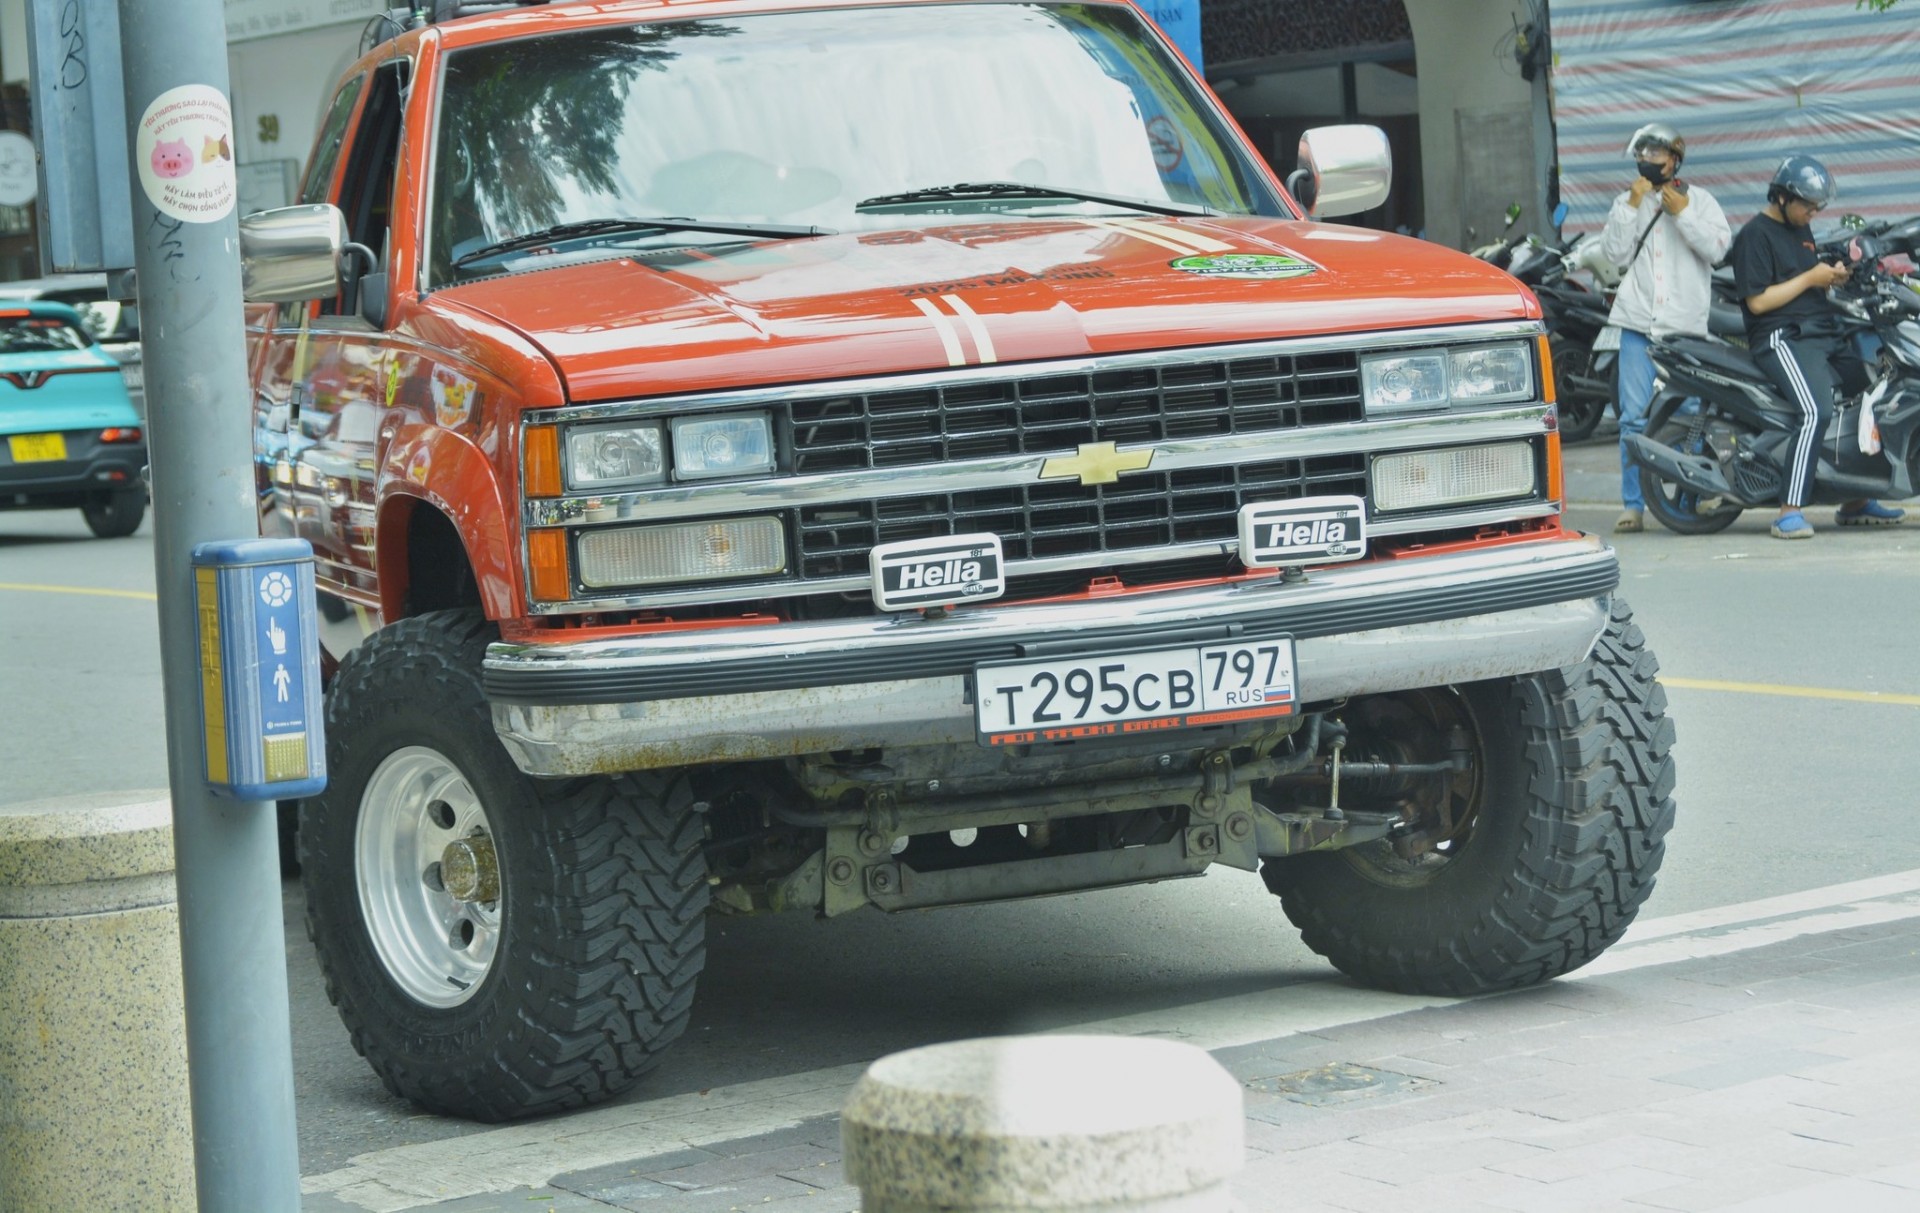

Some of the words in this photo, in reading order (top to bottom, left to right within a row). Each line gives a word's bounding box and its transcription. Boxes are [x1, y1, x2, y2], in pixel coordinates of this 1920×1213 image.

[1269, 520, 1346, 547] Hella
[899, 560, 981, 589] Hella
[1206, 646, 1280, 691] 797
[1226, 688, 1262, 705] RUS
